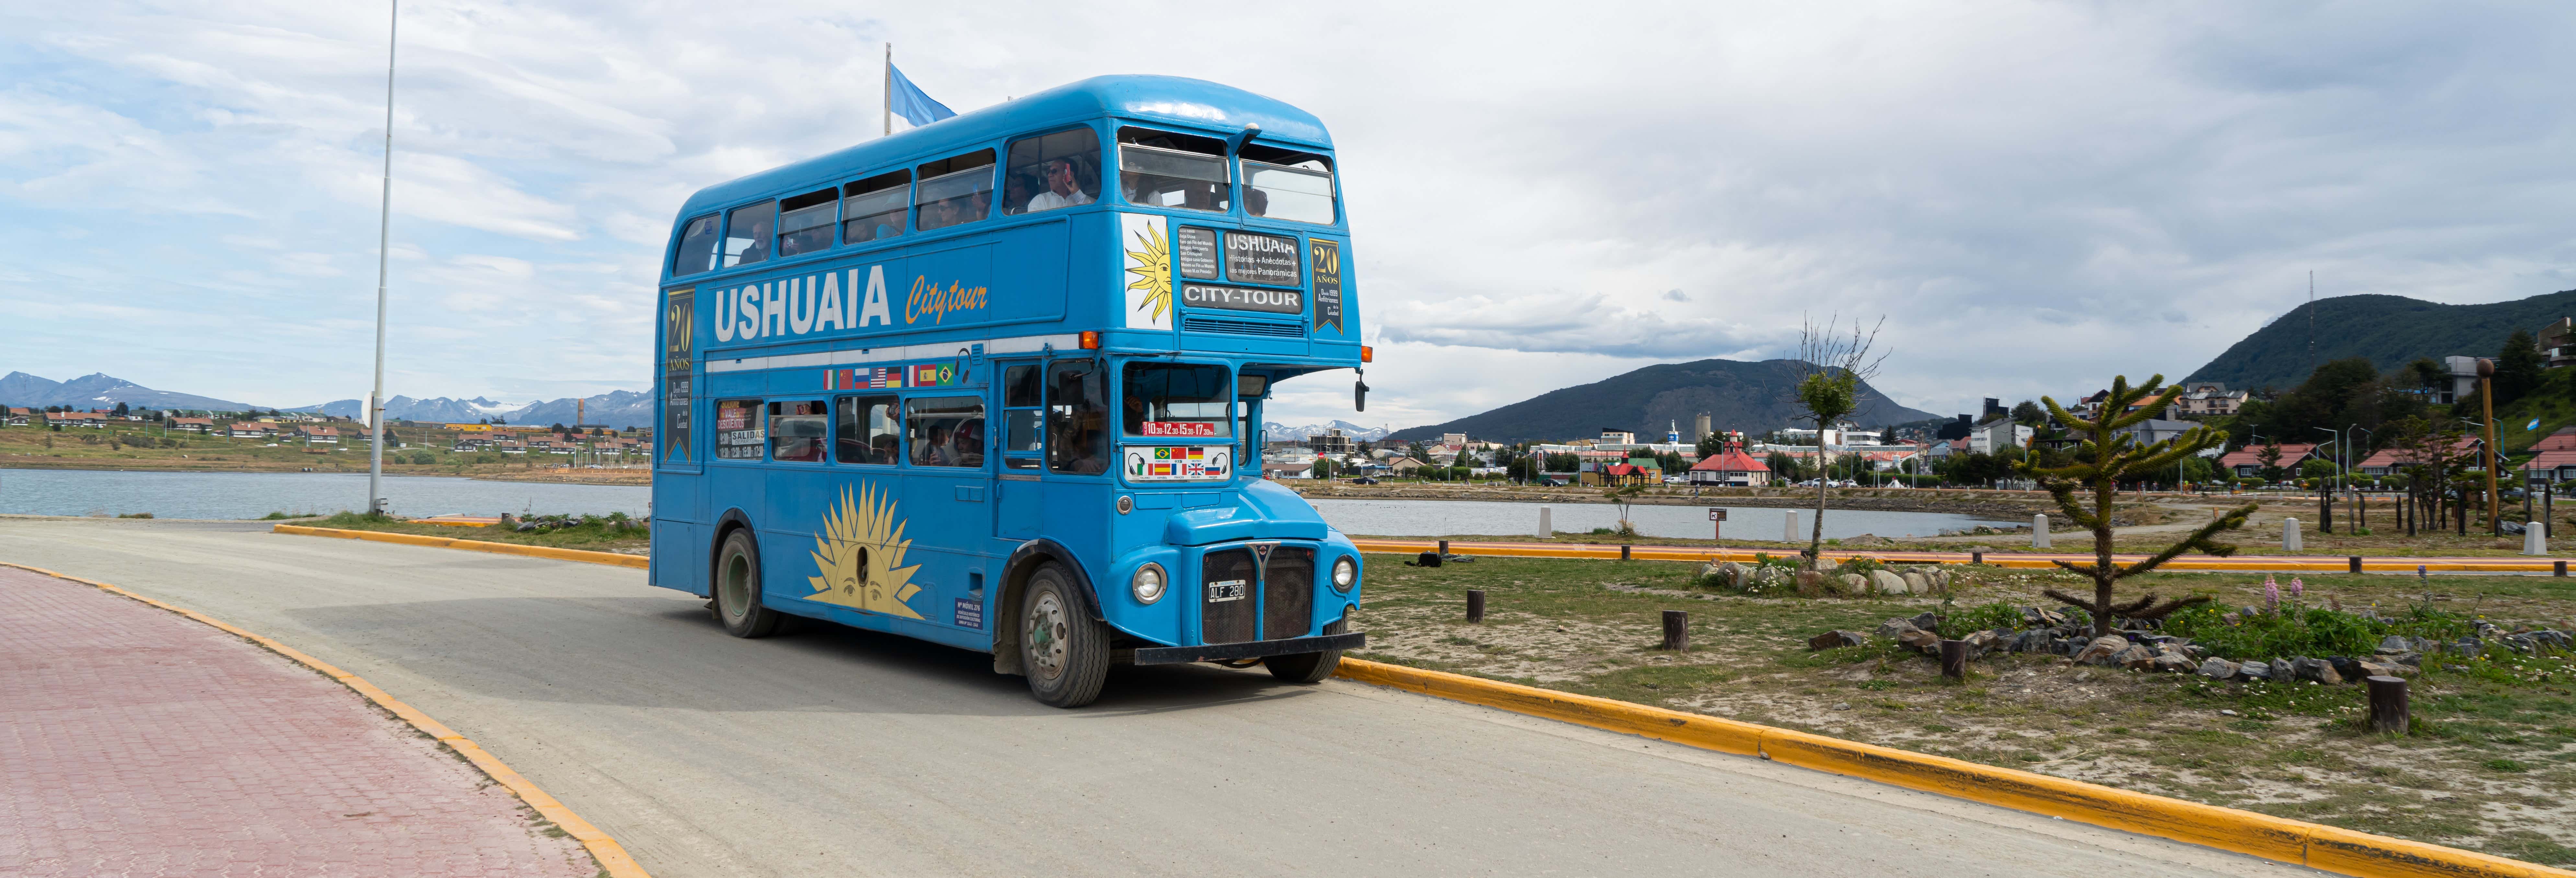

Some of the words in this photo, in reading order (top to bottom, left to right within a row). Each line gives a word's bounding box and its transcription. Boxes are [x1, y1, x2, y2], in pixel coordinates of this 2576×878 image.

[1227, 234, 1295, 254] USHUAIA
[1229, 254, 1255, 263] Historias
[1261, 257, 1291, 266] Anécdotas
[1314, 246, 1337, 275] 20
[1258, 267, 1297, 277] Panorámicas
[1316, 275, 1338, 284] AÑOS
[1185, 287, 1298, 306] CITY-TOUR
[1318, 293, 1338, 303] Anfitriones
[715, 265, 891, 342] USHUAIA
[1328, 307, 1339, 316] Ciudad
[670, 303, 691, 352] 20
[670, 356, 690, 371] AÑOS
[725, 409, 736, 418] VALE
[677, 414, 687, 428] Ciudad
[718, 419, 744, 429] DESCUENTOS
[733, 430, 765, 440] SALIDAS
[1211, 587, 1225, 599] ALF
[1229, 585, 1244, 597] 280
[962, 601, 973, 610] MÓVIL
